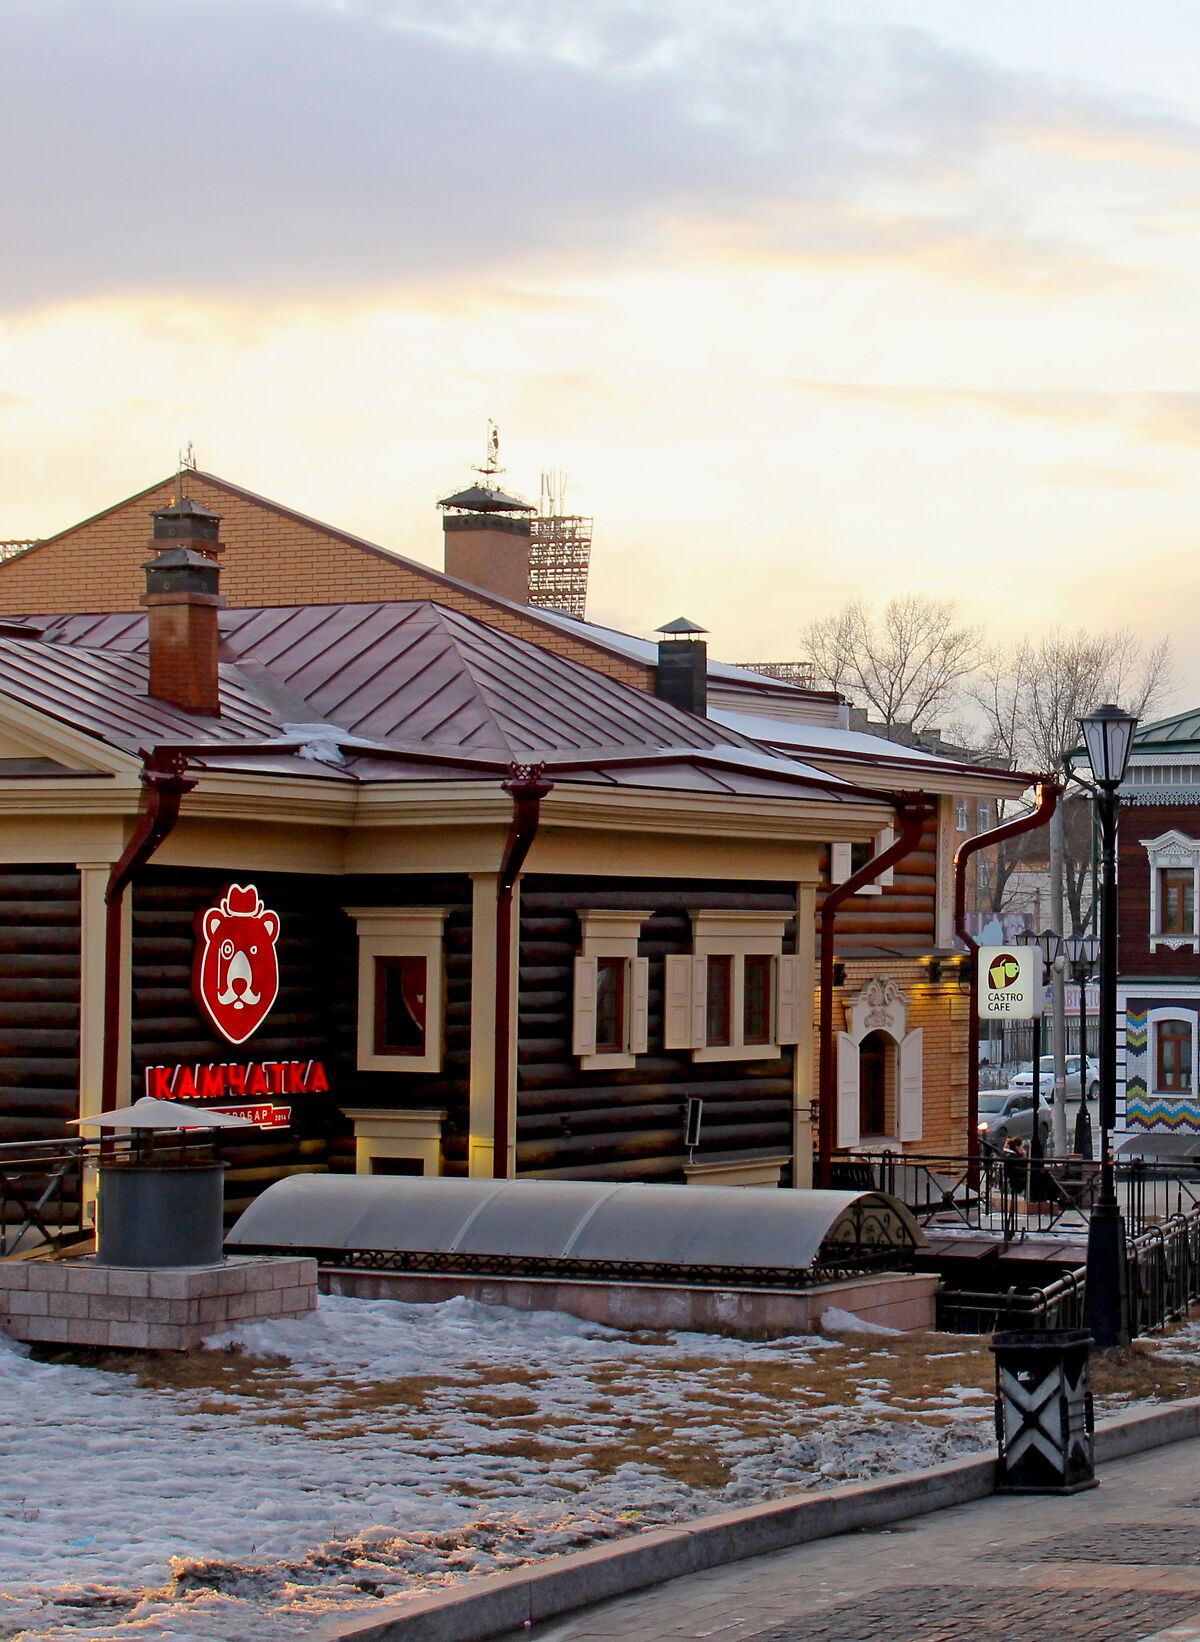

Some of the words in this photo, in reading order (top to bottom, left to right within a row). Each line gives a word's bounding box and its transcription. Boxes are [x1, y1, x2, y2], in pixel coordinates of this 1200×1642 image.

[987, 992, 1023, 1001] CASTRO
[987, 1002, 1010, 1011] CAFE
[146, 1060, 329, 1099] КАМЧАТКА
